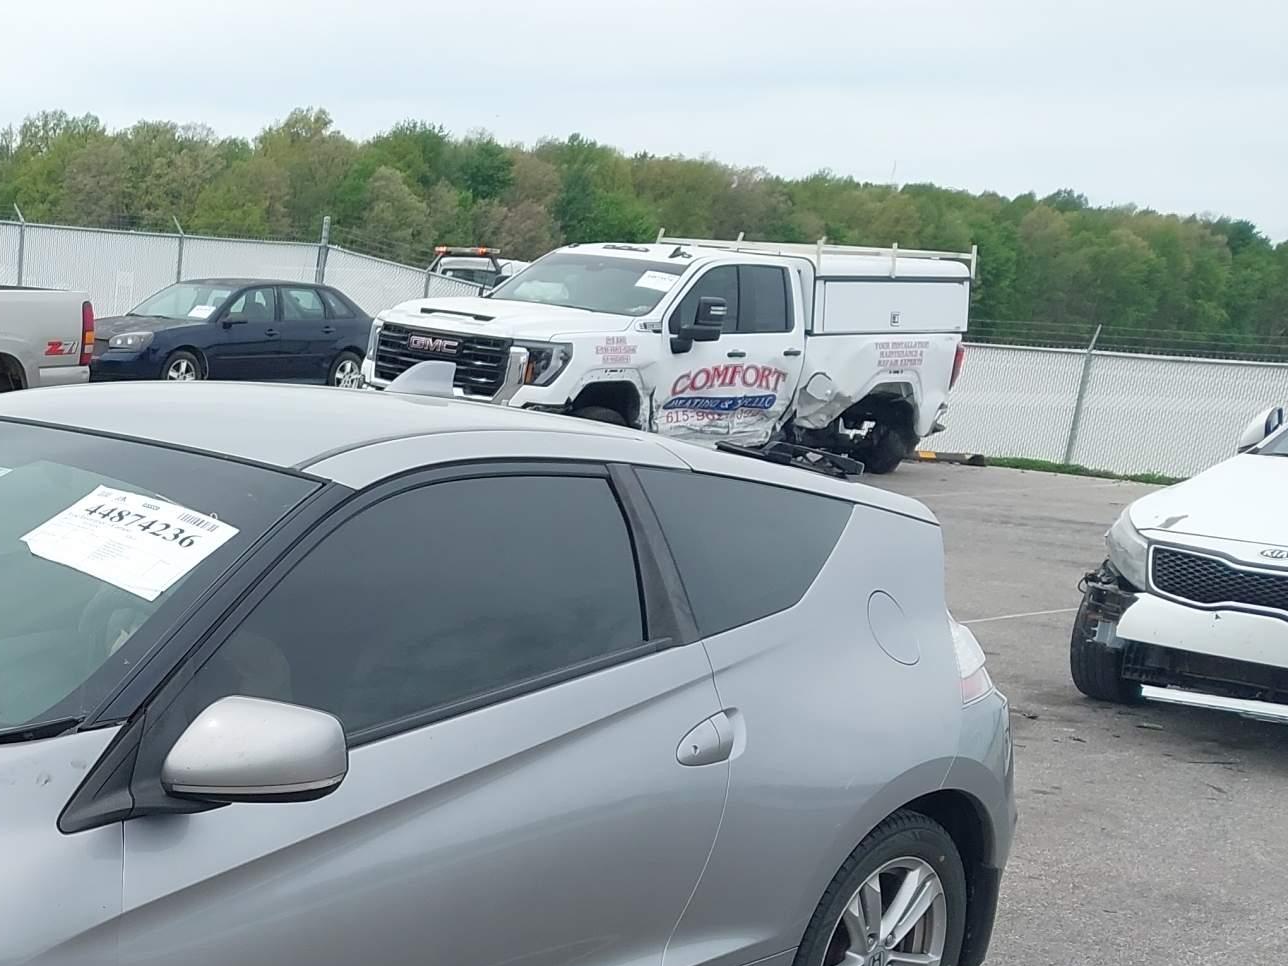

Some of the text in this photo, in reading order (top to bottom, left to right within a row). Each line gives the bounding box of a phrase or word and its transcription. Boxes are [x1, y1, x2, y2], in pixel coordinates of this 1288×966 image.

[44, 341, 79, 355] Z71
[410, 335, 458, 353] GMC
[671, 362, 788, 396] COMFORT
[668, 398, 718, 410] HEATING
[85, 504, 203, 549] 44874236
